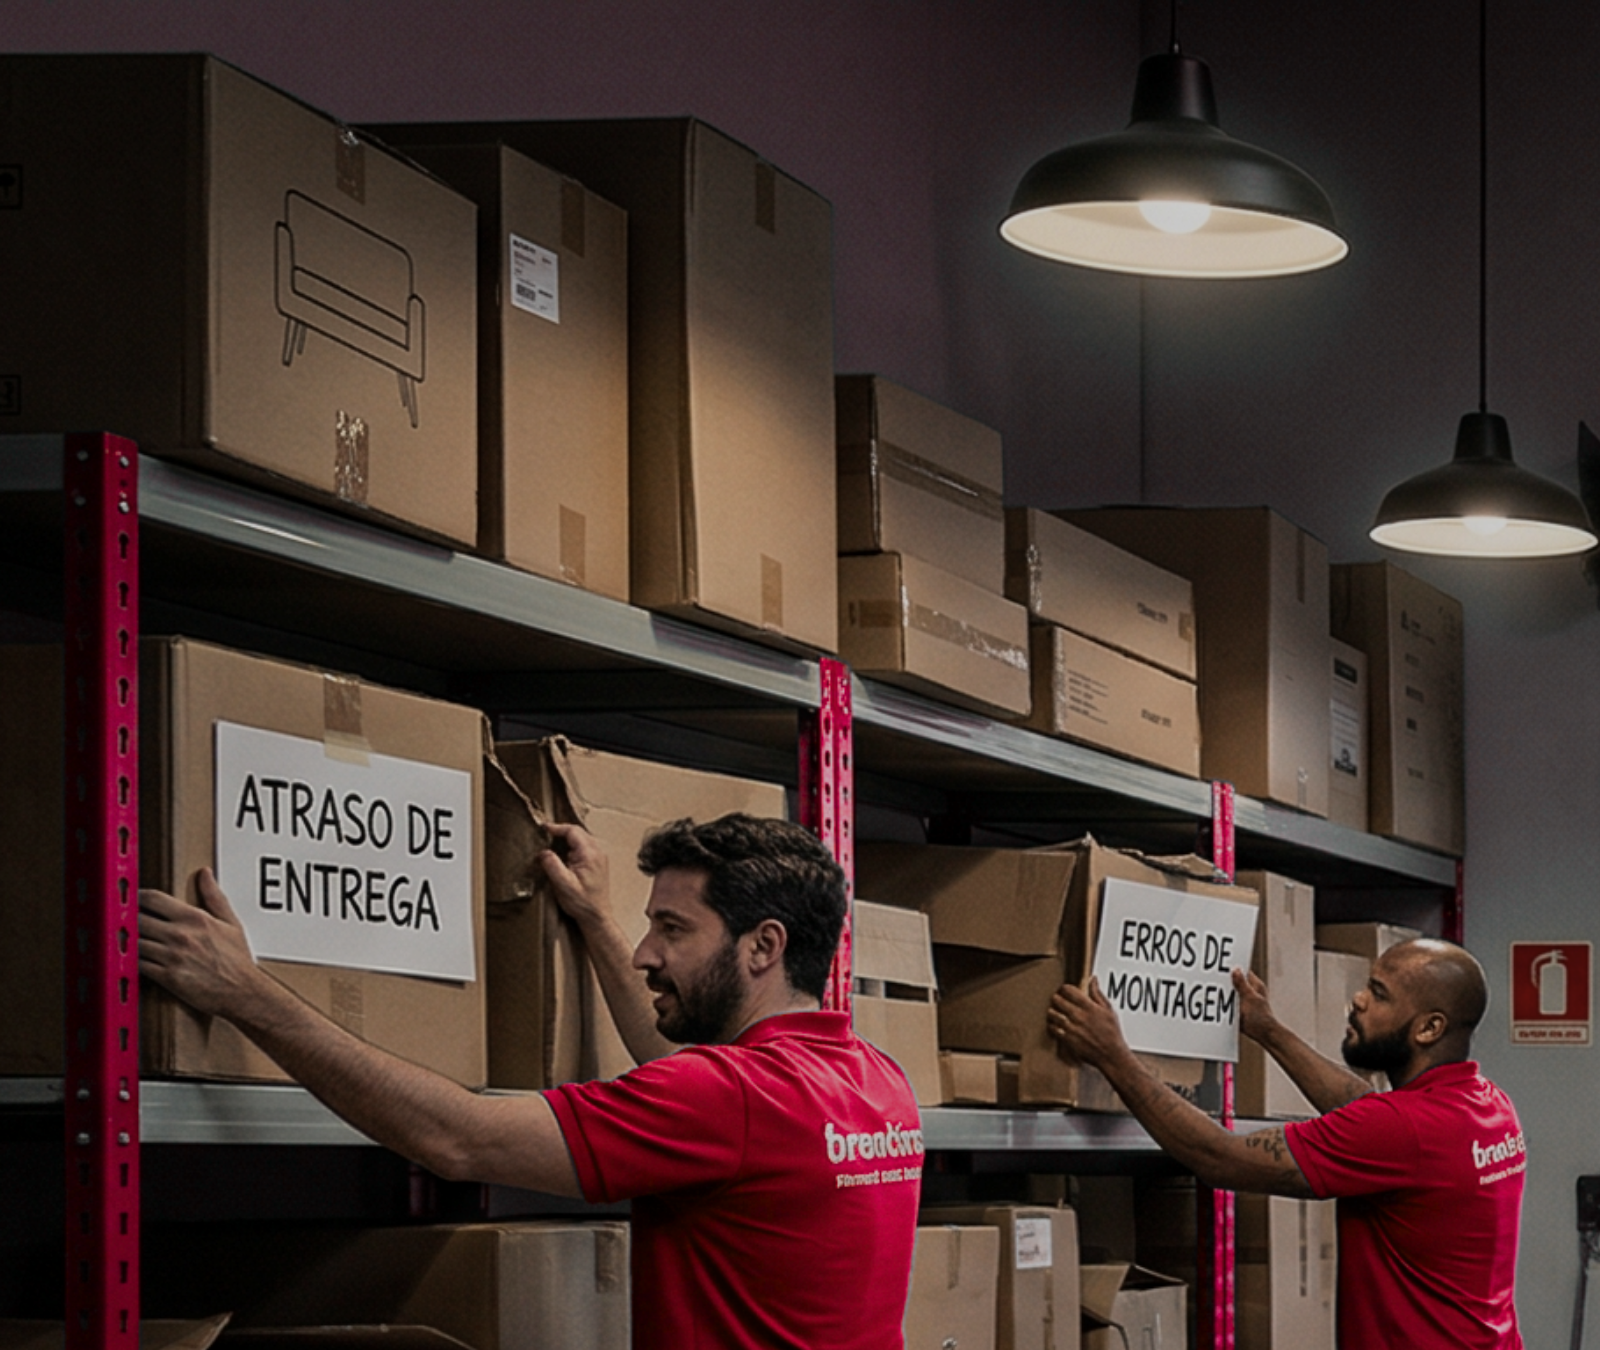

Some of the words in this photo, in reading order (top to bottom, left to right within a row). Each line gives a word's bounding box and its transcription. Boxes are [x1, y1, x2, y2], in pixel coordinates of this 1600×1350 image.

[236, 774, 394, 850] ATRASO
[407, 803, 454, 860] DE
[259, 856, 441, 932] ENTREGA
[1119, 919, 1197, 968] ERROS
[1203, 933, 1234, 974] DE
[1107, 971, 1236, 1026] MONTAGEM
